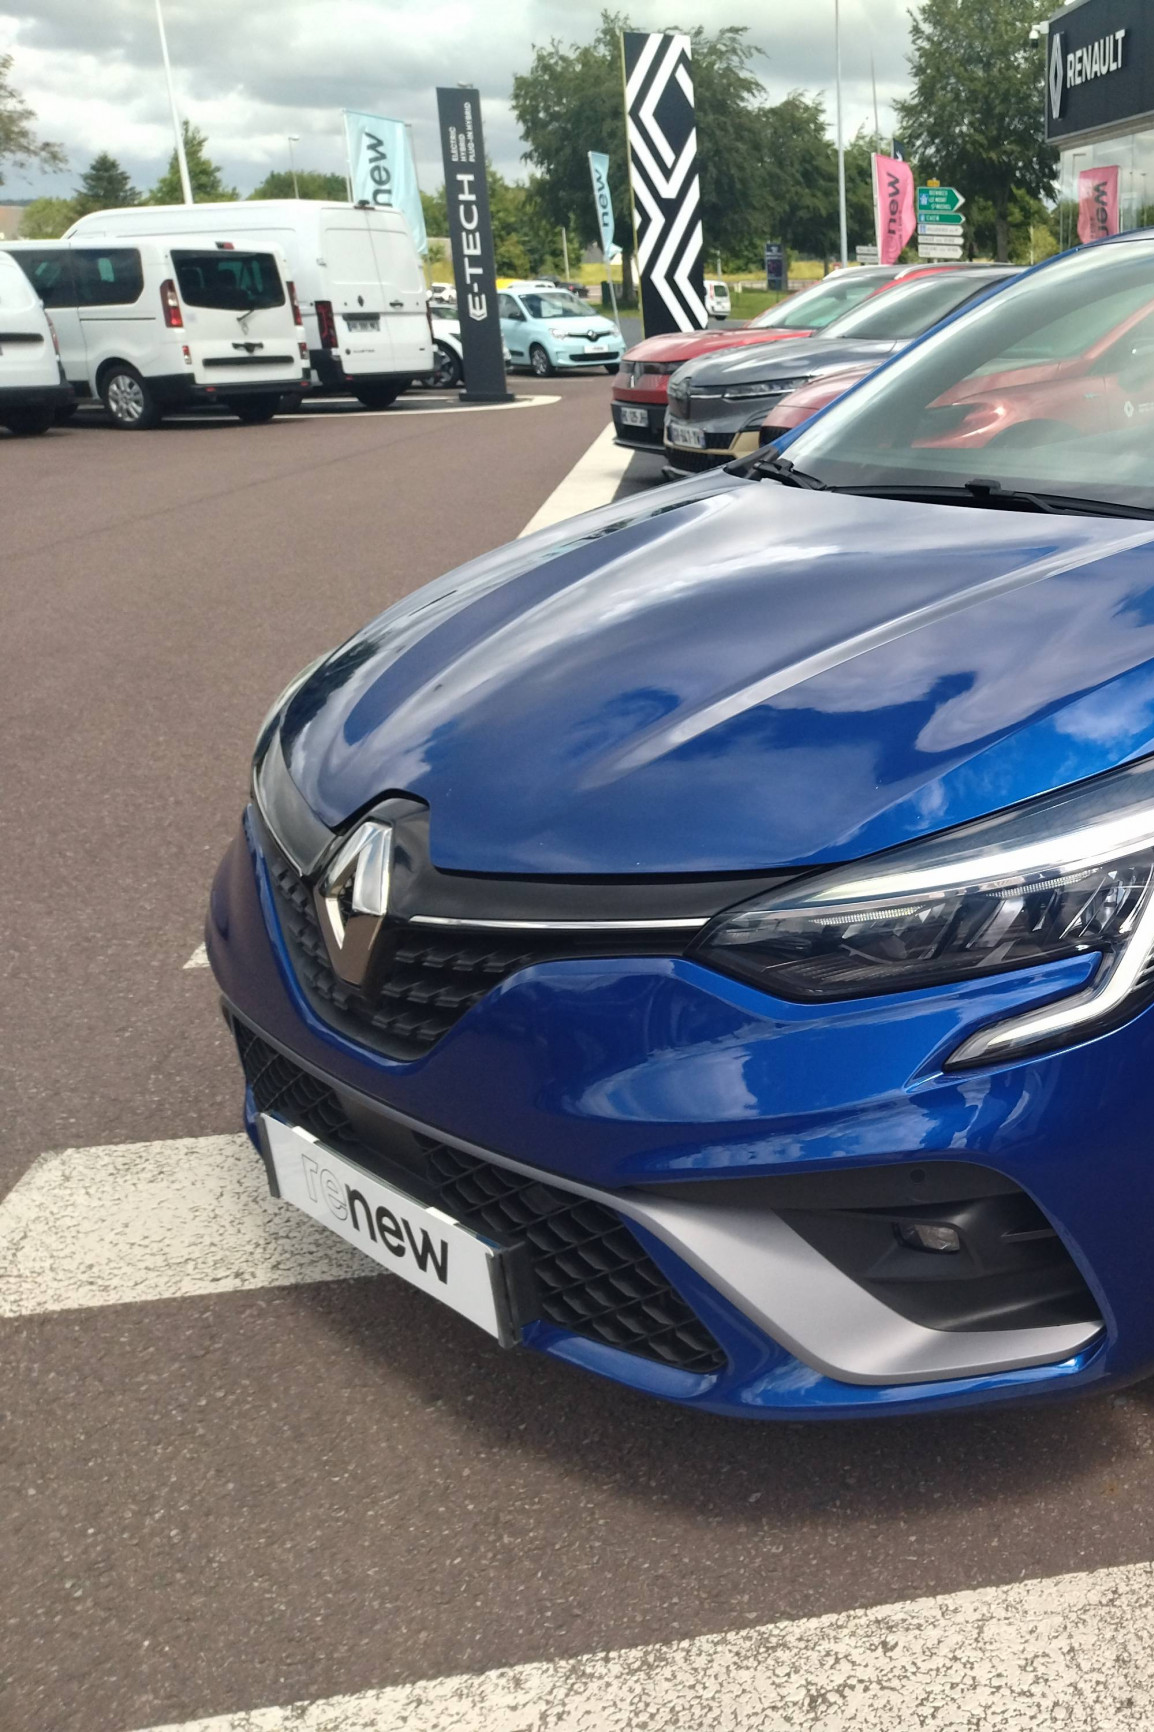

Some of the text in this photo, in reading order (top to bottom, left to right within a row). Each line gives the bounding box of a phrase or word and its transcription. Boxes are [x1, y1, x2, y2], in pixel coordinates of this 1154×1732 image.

[1066, 28, 1126, 89] RENAULT
[449, 126, 459, 162] ELECTRIC
[458, 133, 467, 162] HYBRID
[463, 101, 476, 162] PLUG-IN HYBRID
[364, 131, 394, 208] new
[595, 168, 610, 228] new
[456, 173, 488, 321] E-TECH
[301, 1153, 449, 1285] renew
